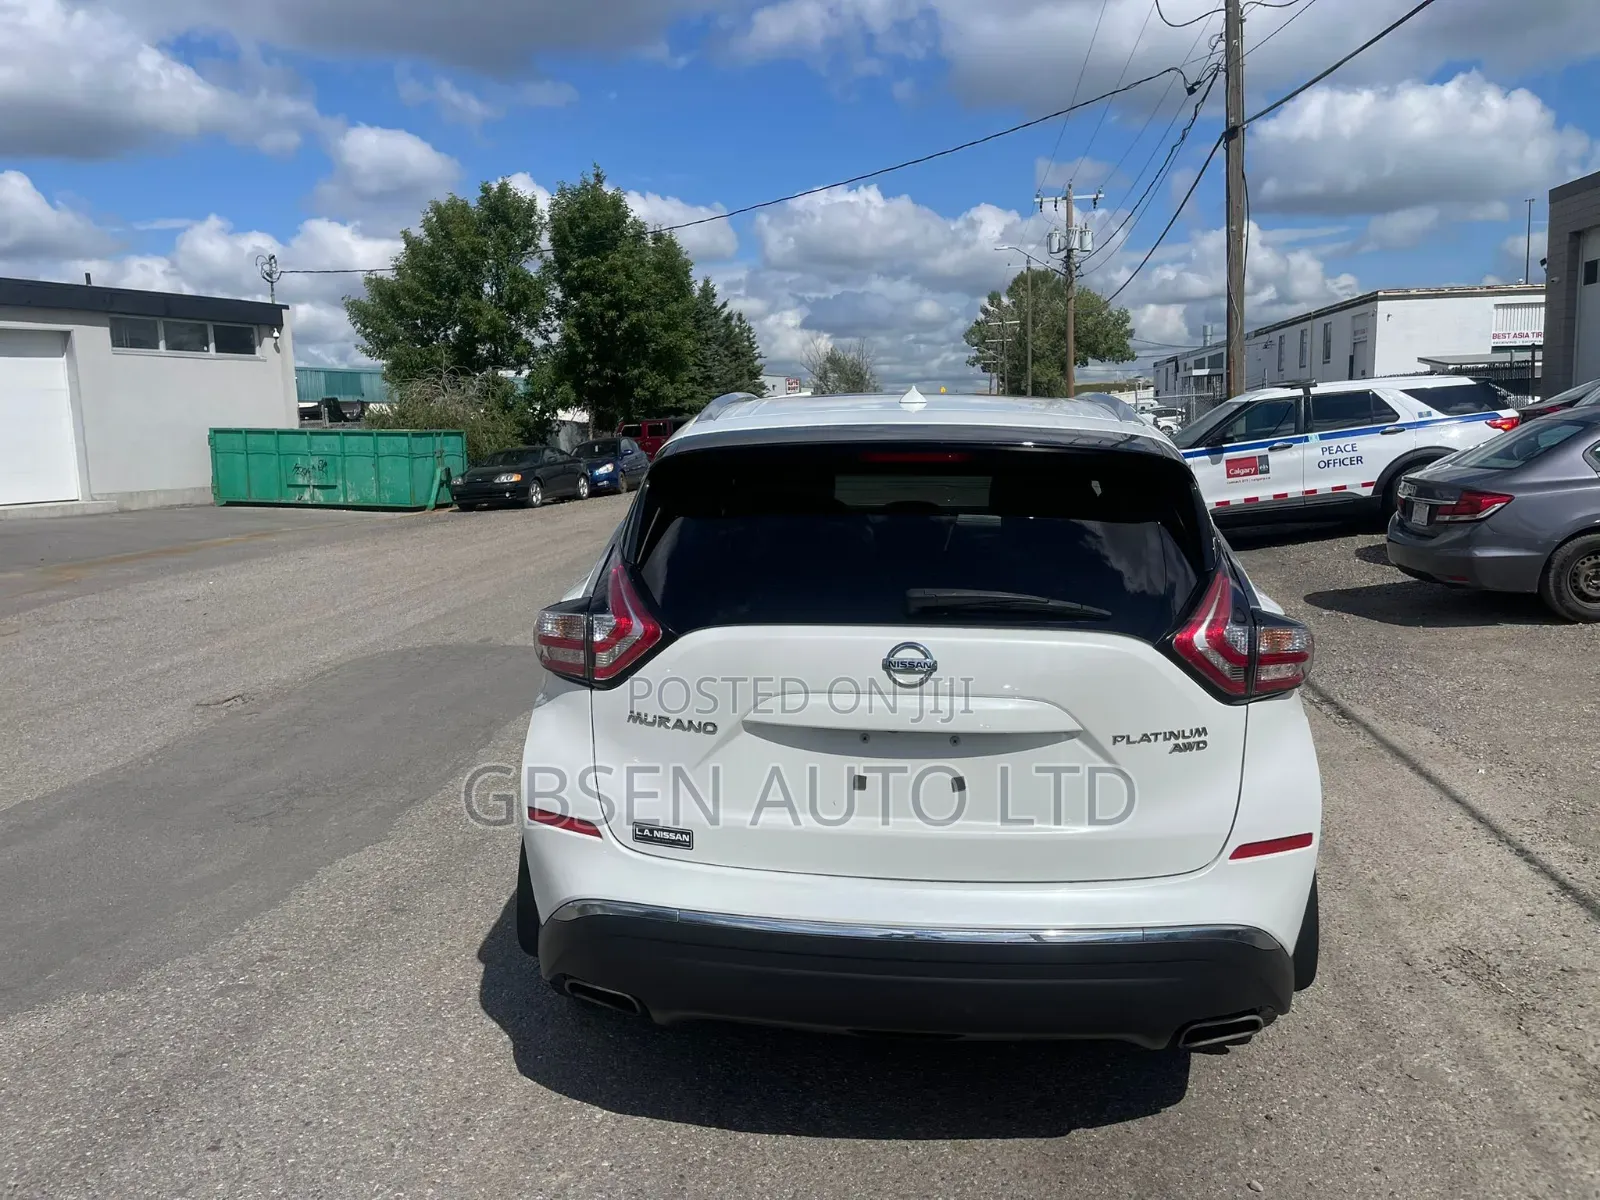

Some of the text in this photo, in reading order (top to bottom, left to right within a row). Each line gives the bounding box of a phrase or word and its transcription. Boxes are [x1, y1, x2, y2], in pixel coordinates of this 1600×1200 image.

[1321, 443, 1358, 456] PEACE
[1317, 455, 1363, 469] OFFICER
[1229, 467, 1255, 475] Calgary
[888, 660, 932, 669] NISSAN
[627, 710, 718, 735] MURANO
[1112, 726, 1208, 746] PLATINUM
[1168, 740, 1208, 754] AWD
[653, 830, 690, 842] NISSAN
